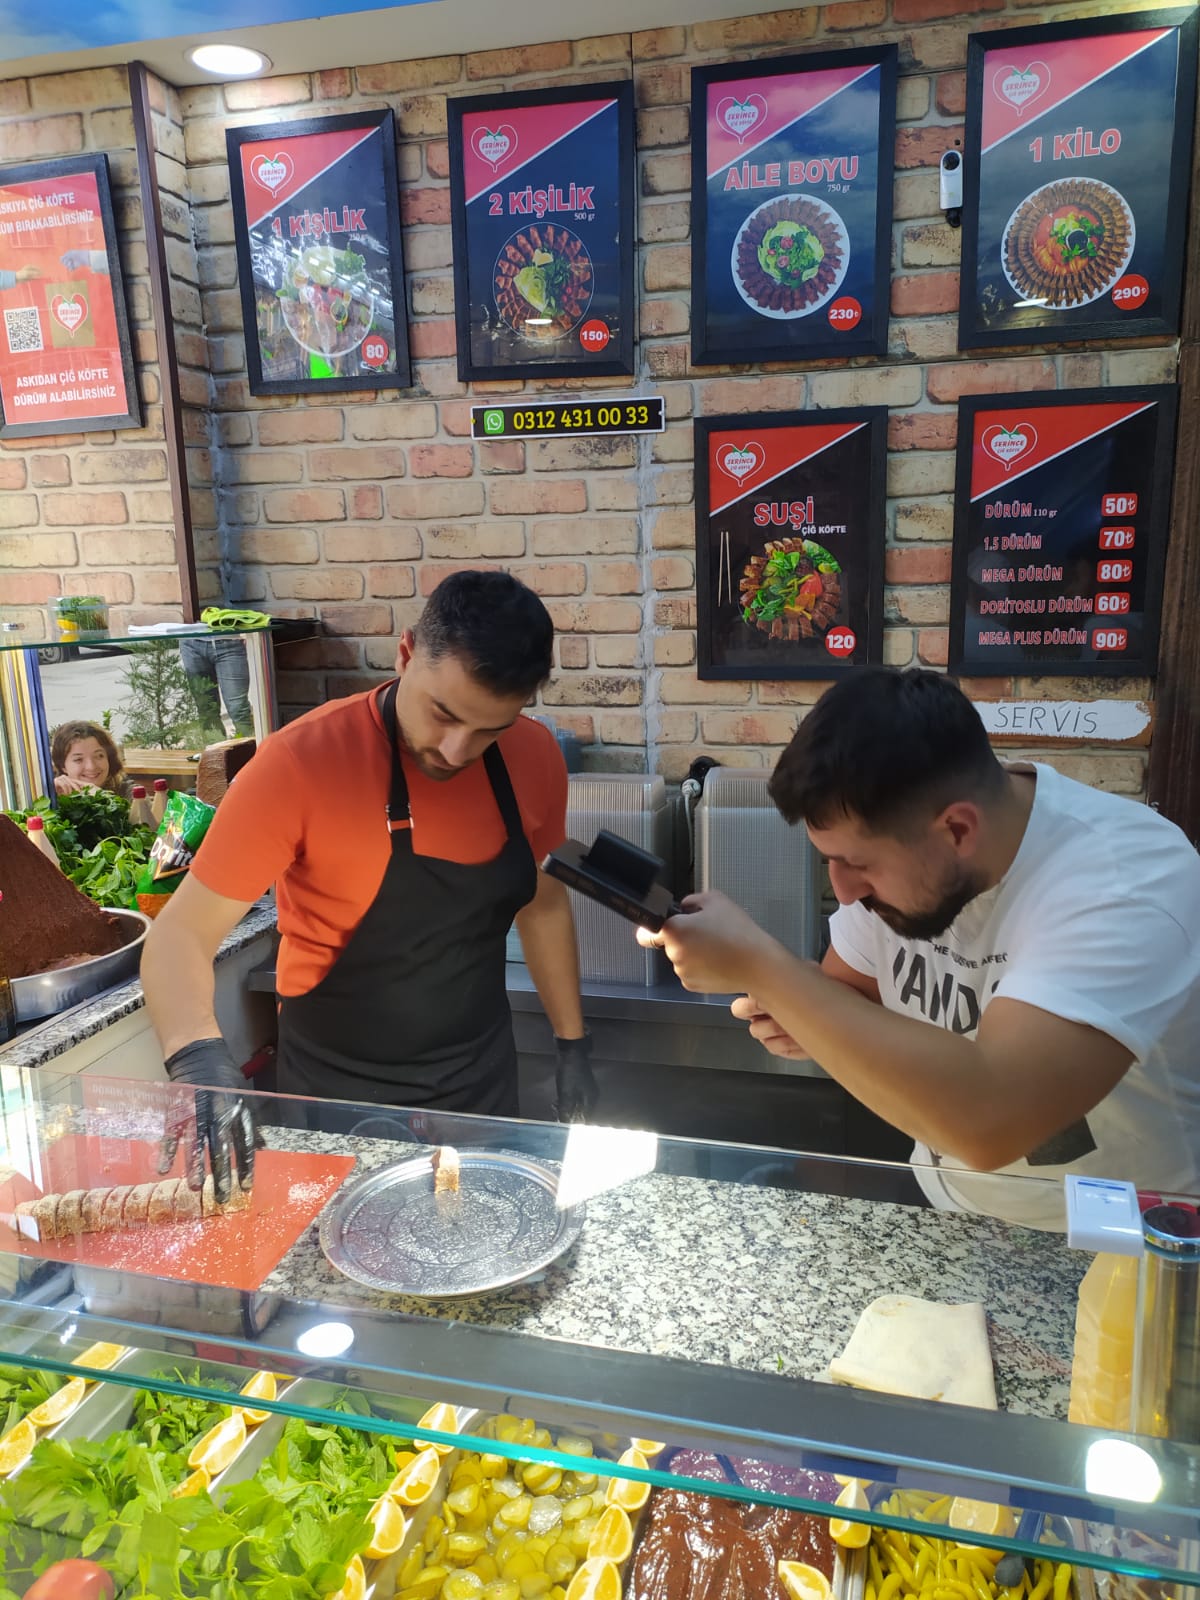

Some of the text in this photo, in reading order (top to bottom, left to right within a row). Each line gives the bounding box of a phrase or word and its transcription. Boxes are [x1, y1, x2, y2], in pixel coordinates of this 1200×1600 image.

[1029, 126, 1121, 163] 1 KİLO
[723, 155, 858, 191] AİLE BOYU
[827, 184, 851, 194] 750 gr
[0, 200, 27, 215] SKIYA
[46, 192, 75, 207] KÖFTE
[488, 182, 595, 219] 2 KİŞİLİK
[271, 205, 367, 240] 1 KİŞİLİK
[574, 212, 587, 221] 500
[366, 344, 385, 359] 80
[16, 367, 108, 388] ASKIDAN ÇİĞ KÖFTE
[13, 384, 116, 407] DÜRÜM ALABİLİRSİNİZ
[513, 405, 648, 430] 0312 431 00 33
[753, 495, 814, 531] SUŞİ
[984, 500, 1032, 519] DÜRÜM
[1033, 508, 1047, 517] 110
[1048, 509, 1058, 519] gr
[801, 524, 846, 536] ÇİĞ KÖFTE
[983, 536, 999, 551] 1.5
[1001, 532, 1042, 550] DÜRÜM
[981, 567, 1015, 583] MEGA
[1018, 564, 1063, 582] DÜRÜM
[979, 596, 1045, 614] DORİTOSLU
[1048, 595, 1093, 613] DÜRÜM
[826, 634, 855, 649] 120
[978, 630, 1011, 645] MEGA
[1013, 629, 1042, 645] PLUS
[1043, 627, 1087, 645] DÜRÜM
